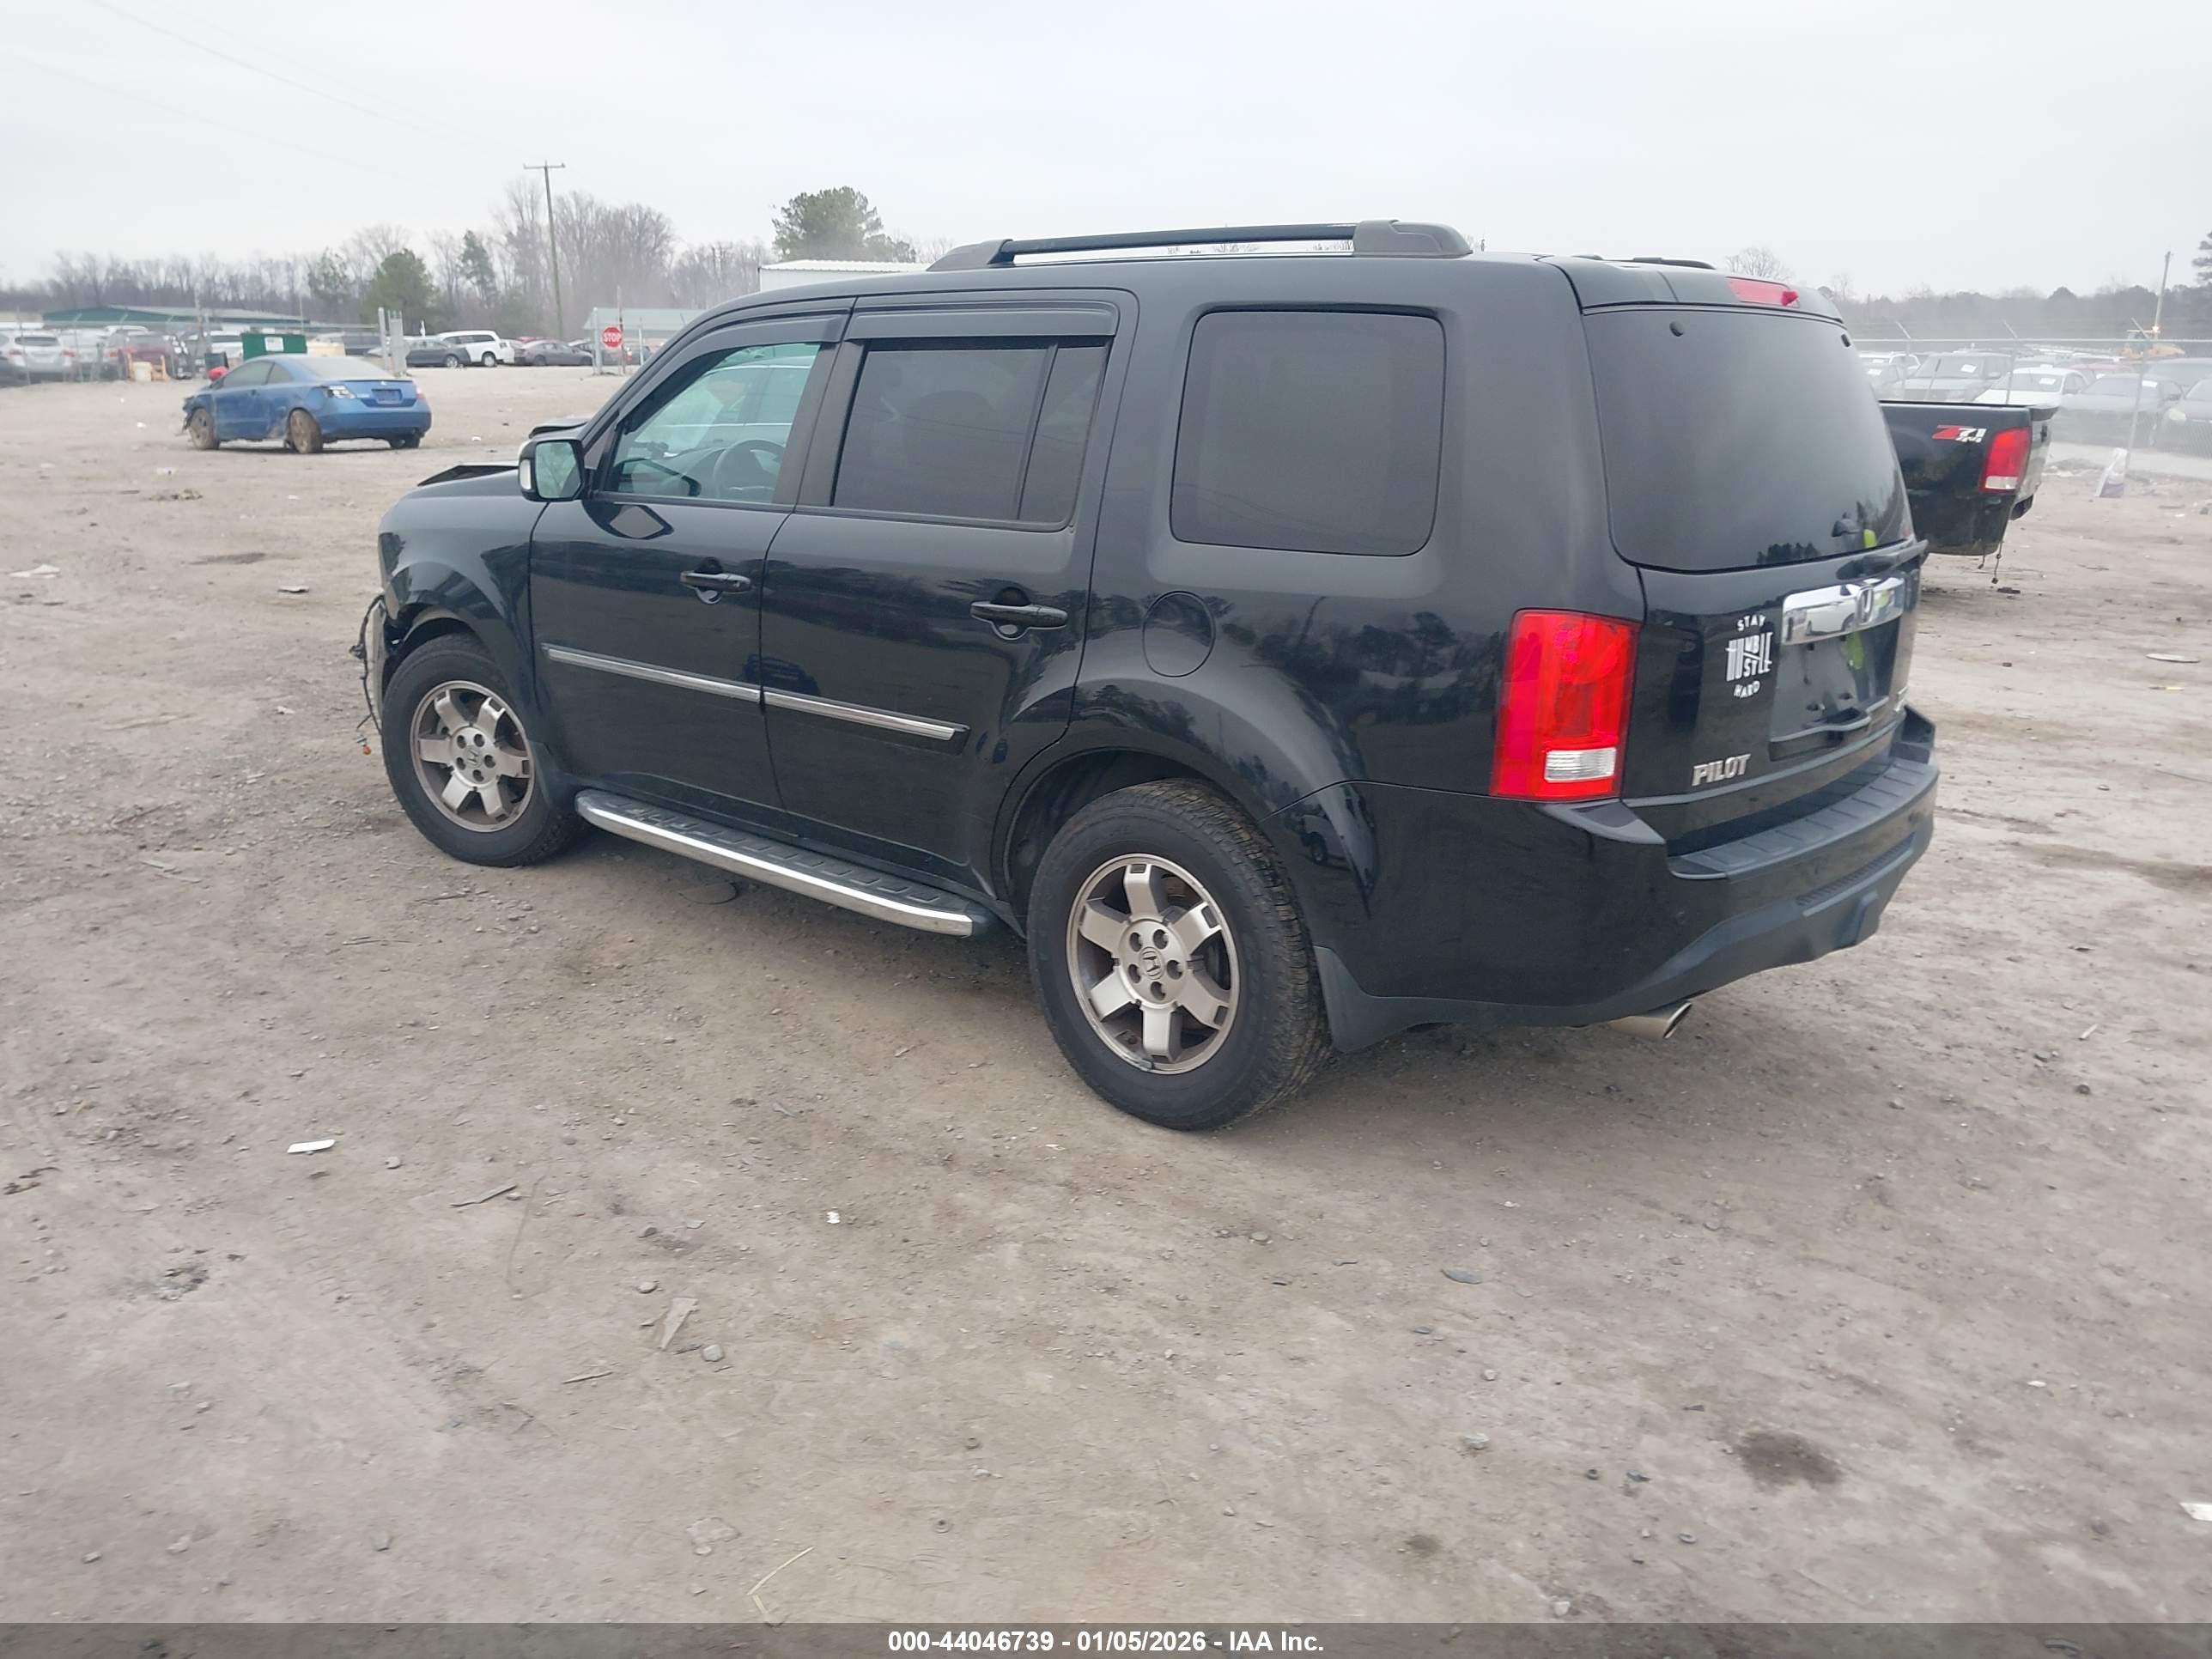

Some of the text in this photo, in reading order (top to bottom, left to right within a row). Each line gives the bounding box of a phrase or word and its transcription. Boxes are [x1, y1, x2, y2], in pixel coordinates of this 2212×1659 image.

[604, 332, 622, 343] STOP
[1932, 425, 1987, 440] Z71
[1737, 615, 1765, 631] STAY
[1734, 680, 1760, 698] HARD
[1692, 754, 1751, 786] PILOT
